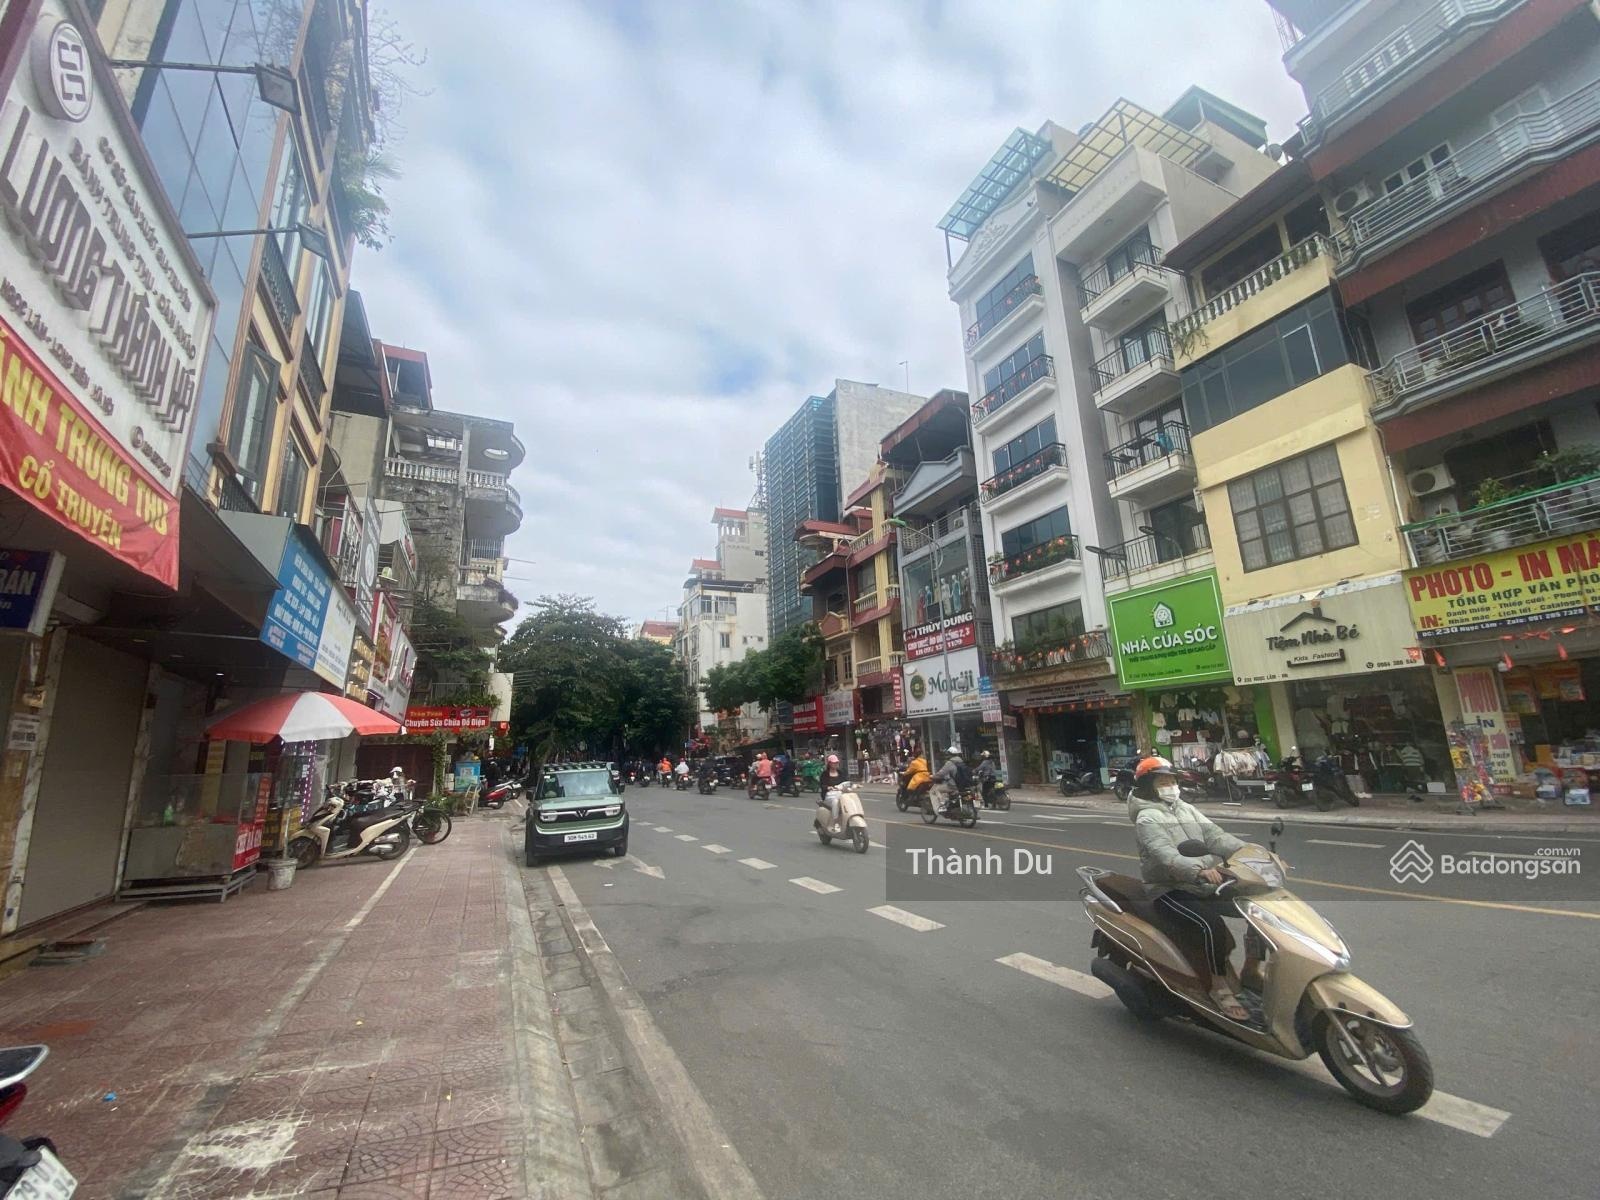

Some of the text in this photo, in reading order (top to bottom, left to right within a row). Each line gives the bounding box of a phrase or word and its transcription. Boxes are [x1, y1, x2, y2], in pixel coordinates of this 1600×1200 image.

[19, 455, 55, 499] CỔ
[55, 406, 132, 507] TRUNG
[135, 478, 169, 535] THU
[1408, 562, 1495, 602] PHOTO
[1517, 550, 1553, 582] IN
[1491, 587, 1523, 603] HỢP
[1528, 577, 1562, 595] VĂN
[918, 611, 973, 635] THÙY DUNG
[1419, 614, 1443, 629] IN:
[1152, 630, 1183, 649] CỦA
[1184, 623, 1218, 644] SÓC
[1266, 624, 1360, 650] Tiệm Nhà Bé
[1312, 651, 1339, 660] Fashion
